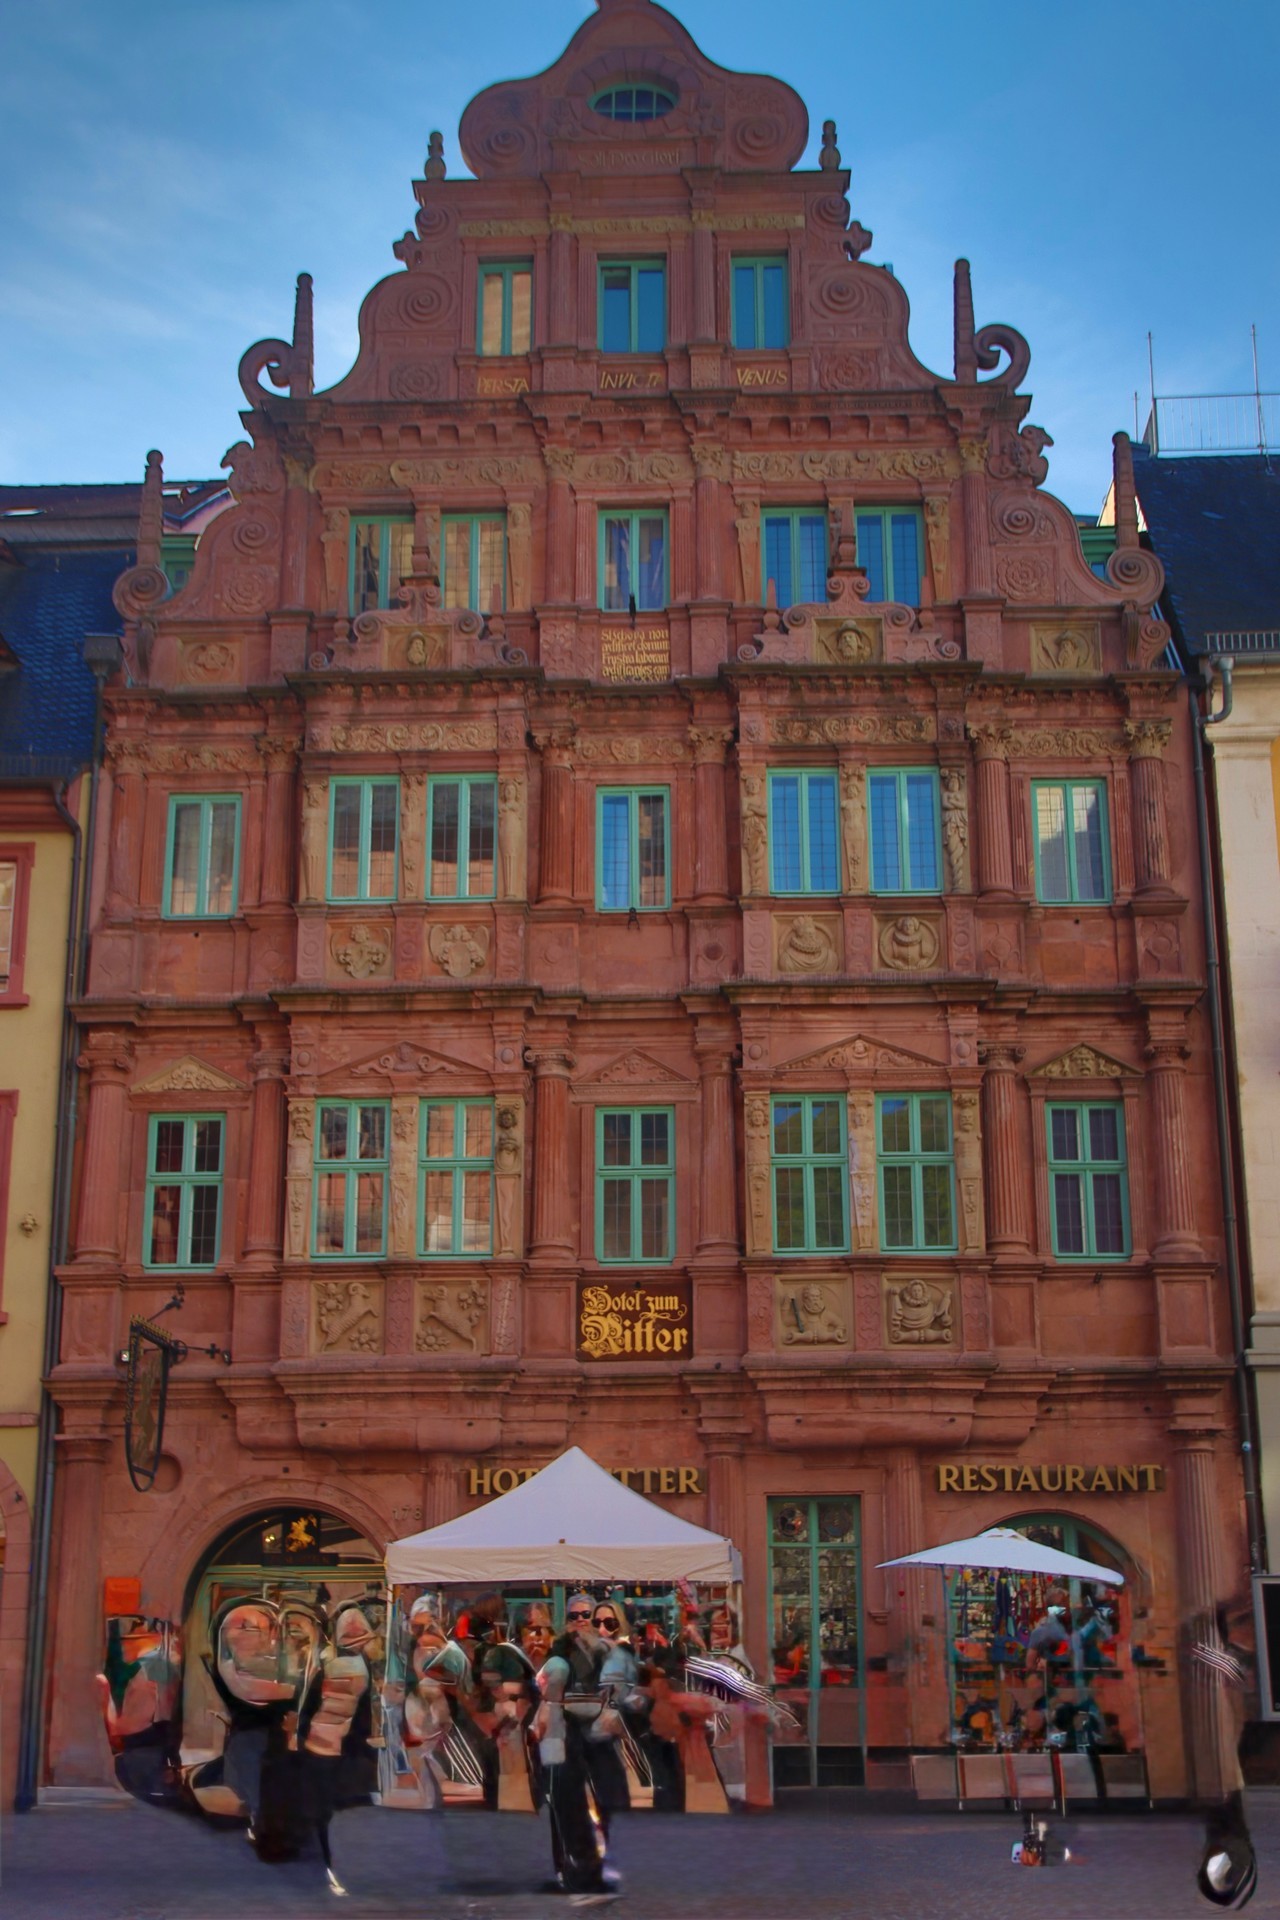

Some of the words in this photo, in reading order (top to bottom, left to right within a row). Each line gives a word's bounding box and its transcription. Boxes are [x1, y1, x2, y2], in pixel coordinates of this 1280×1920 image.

[735, 368, 789, 386] VENUS
[582, 1285, 646, 1315] Hotel
[641, 1295, 685, 1320] zum
[580, 1312, 689, 1359] Ritter
[938, 1464, 1162, 1492] RESTAURANT
[391, 1505, 424, 1521] 178
